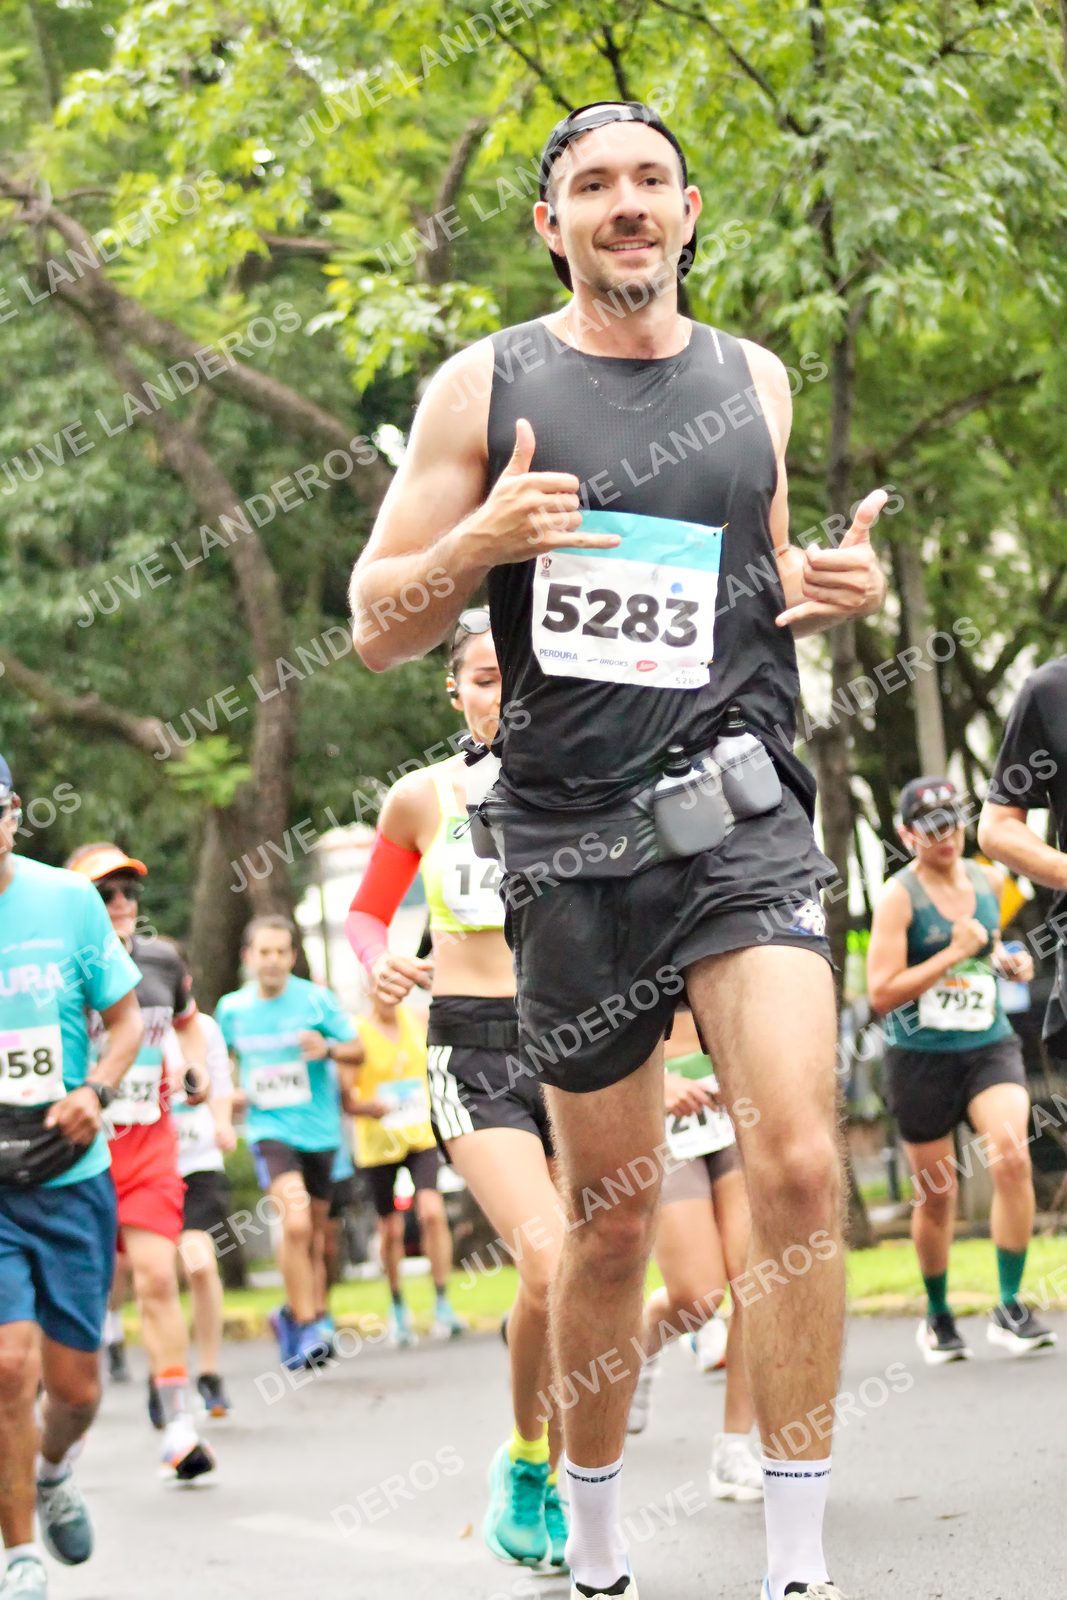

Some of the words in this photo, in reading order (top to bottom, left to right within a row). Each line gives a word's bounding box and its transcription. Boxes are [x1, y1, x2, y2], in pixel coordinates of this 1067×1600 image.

[542, 583, 699, 648] 5283
[540, 649, 578, 661] PERDURA
[936, 990, 985, 1010] 792
[0, 1048, 54, 1079] 58
